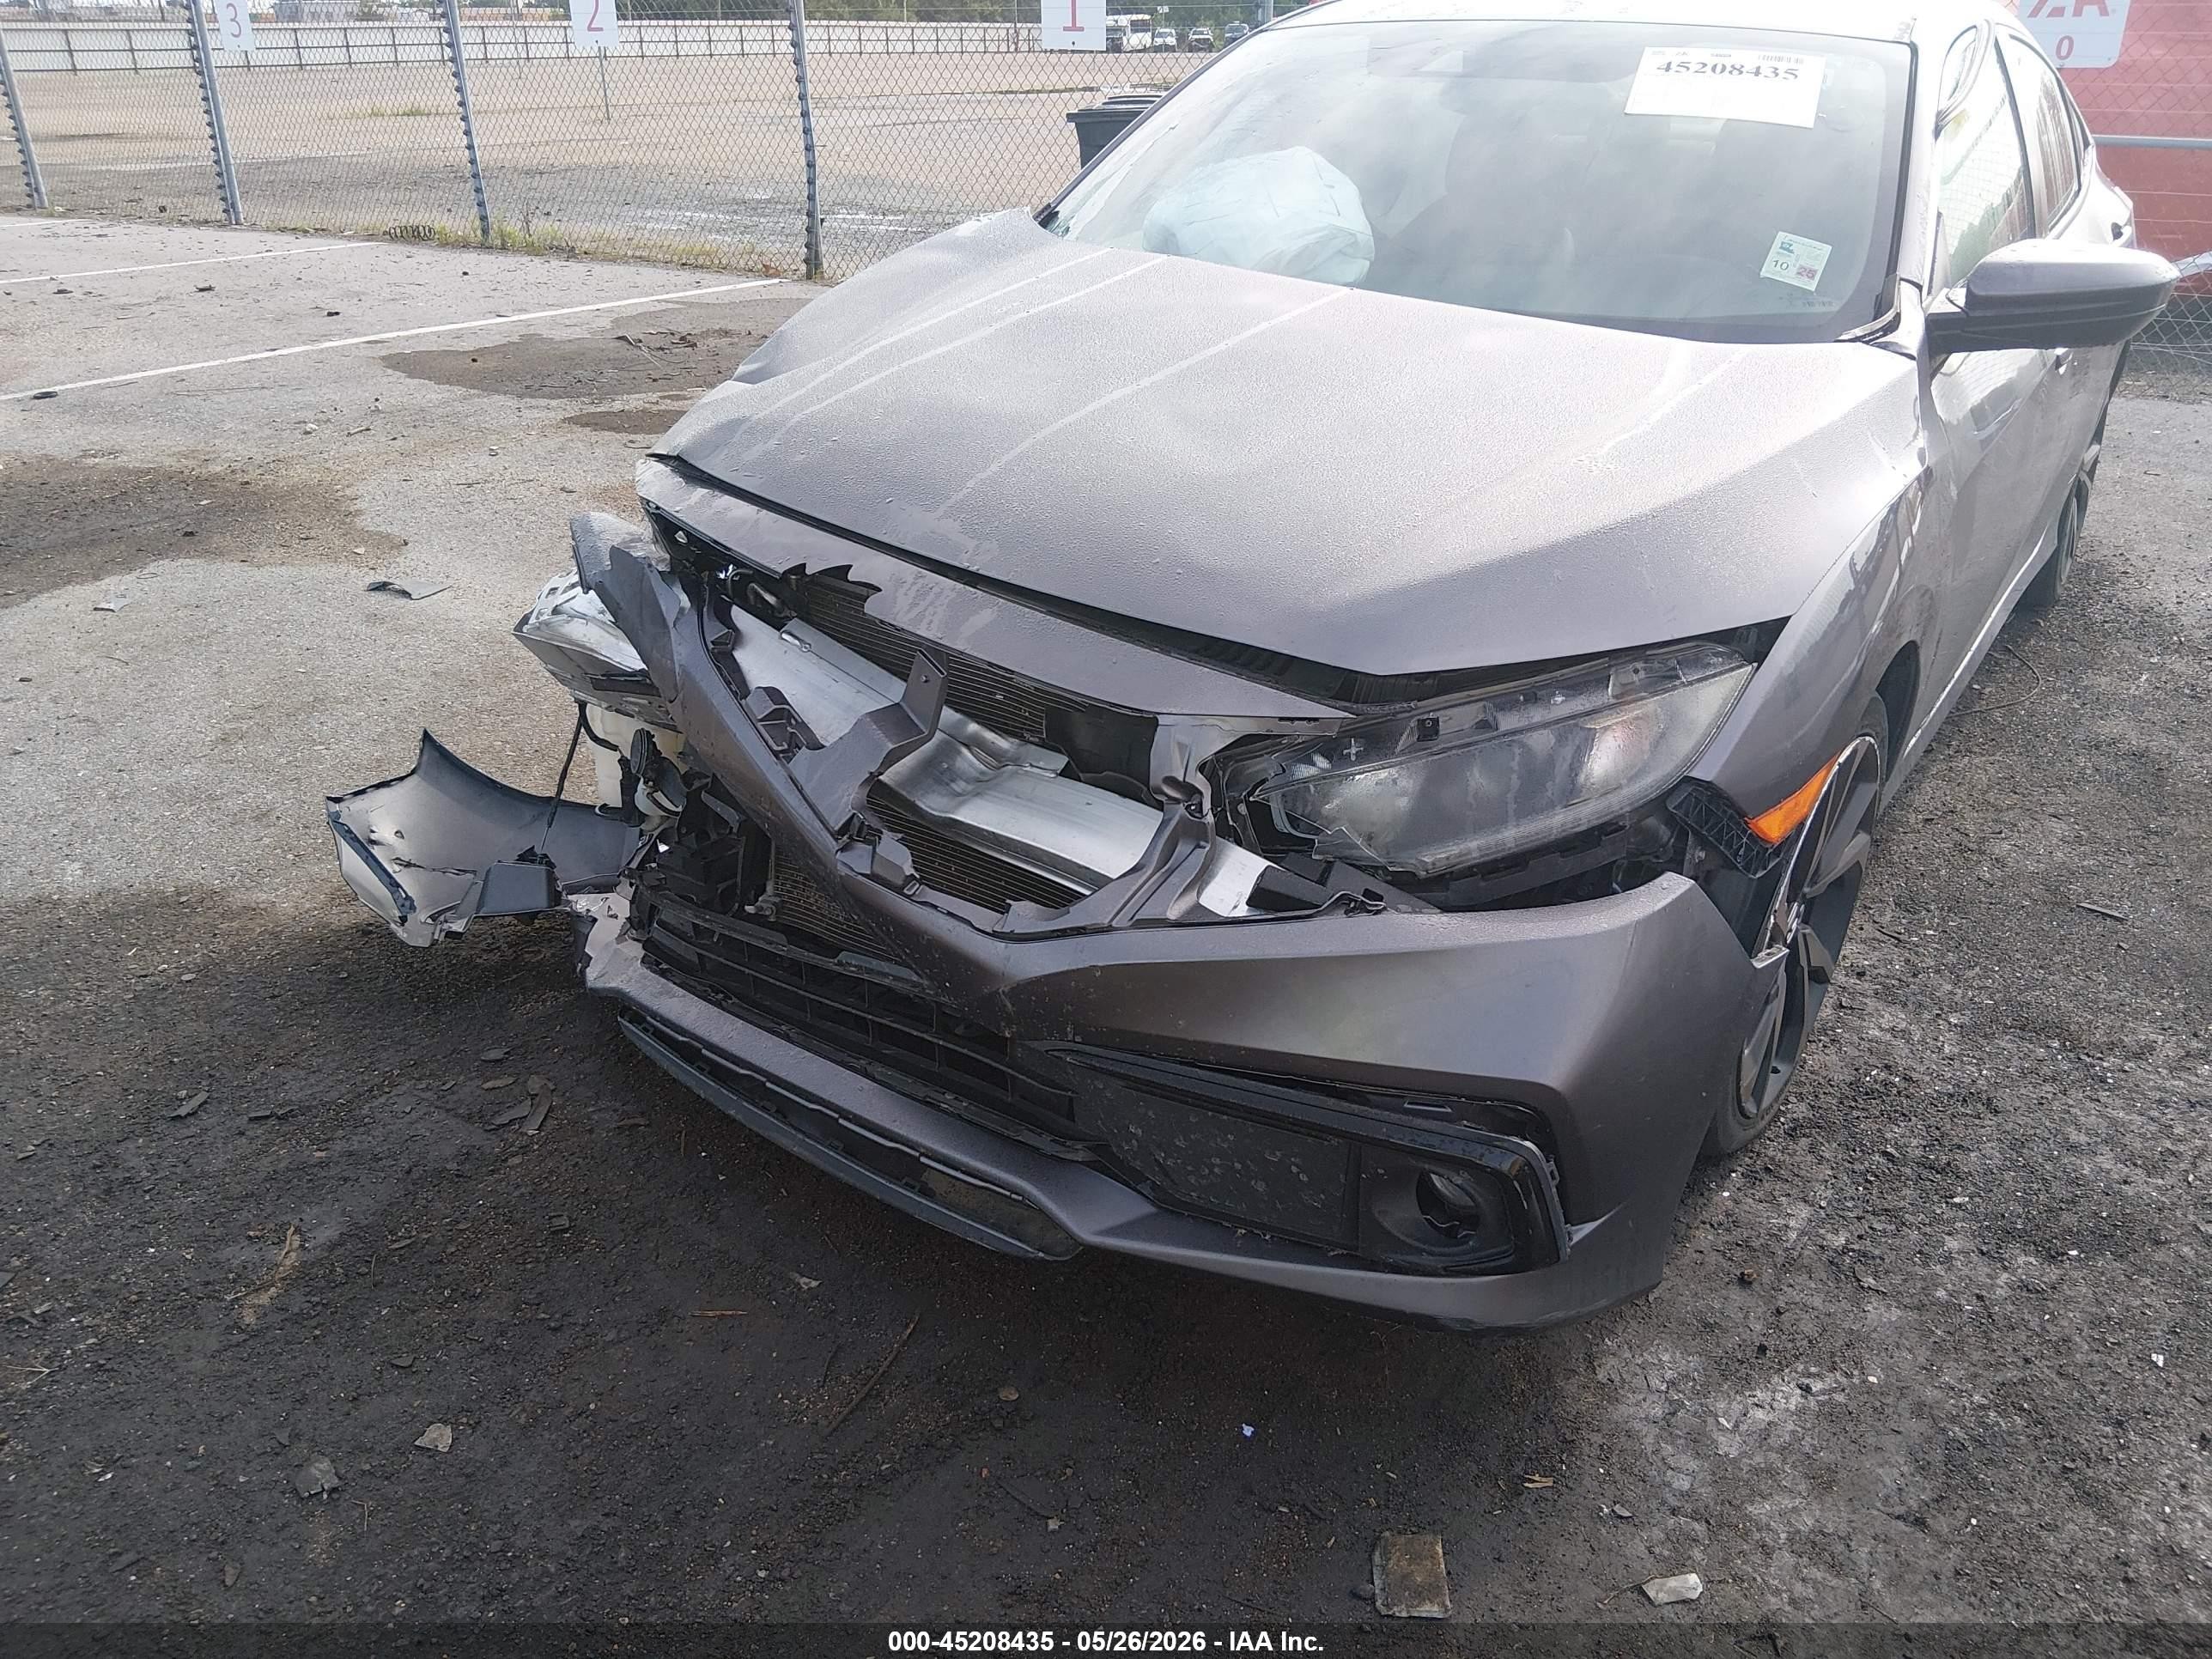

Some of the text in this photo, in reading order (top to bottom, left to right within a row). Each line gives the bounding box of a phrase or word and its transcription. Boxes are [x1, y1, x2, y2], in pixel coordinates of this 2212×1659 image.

[226, 3, 241, 38] 3
[586, 0, 604, 32] 2
[2055, 34, 2075, 60] 0
[1656, 60, 1801, 81] 45208435
[1772, 259, 1790, 270] 10
[1799, 267, 1814, 279] 25
